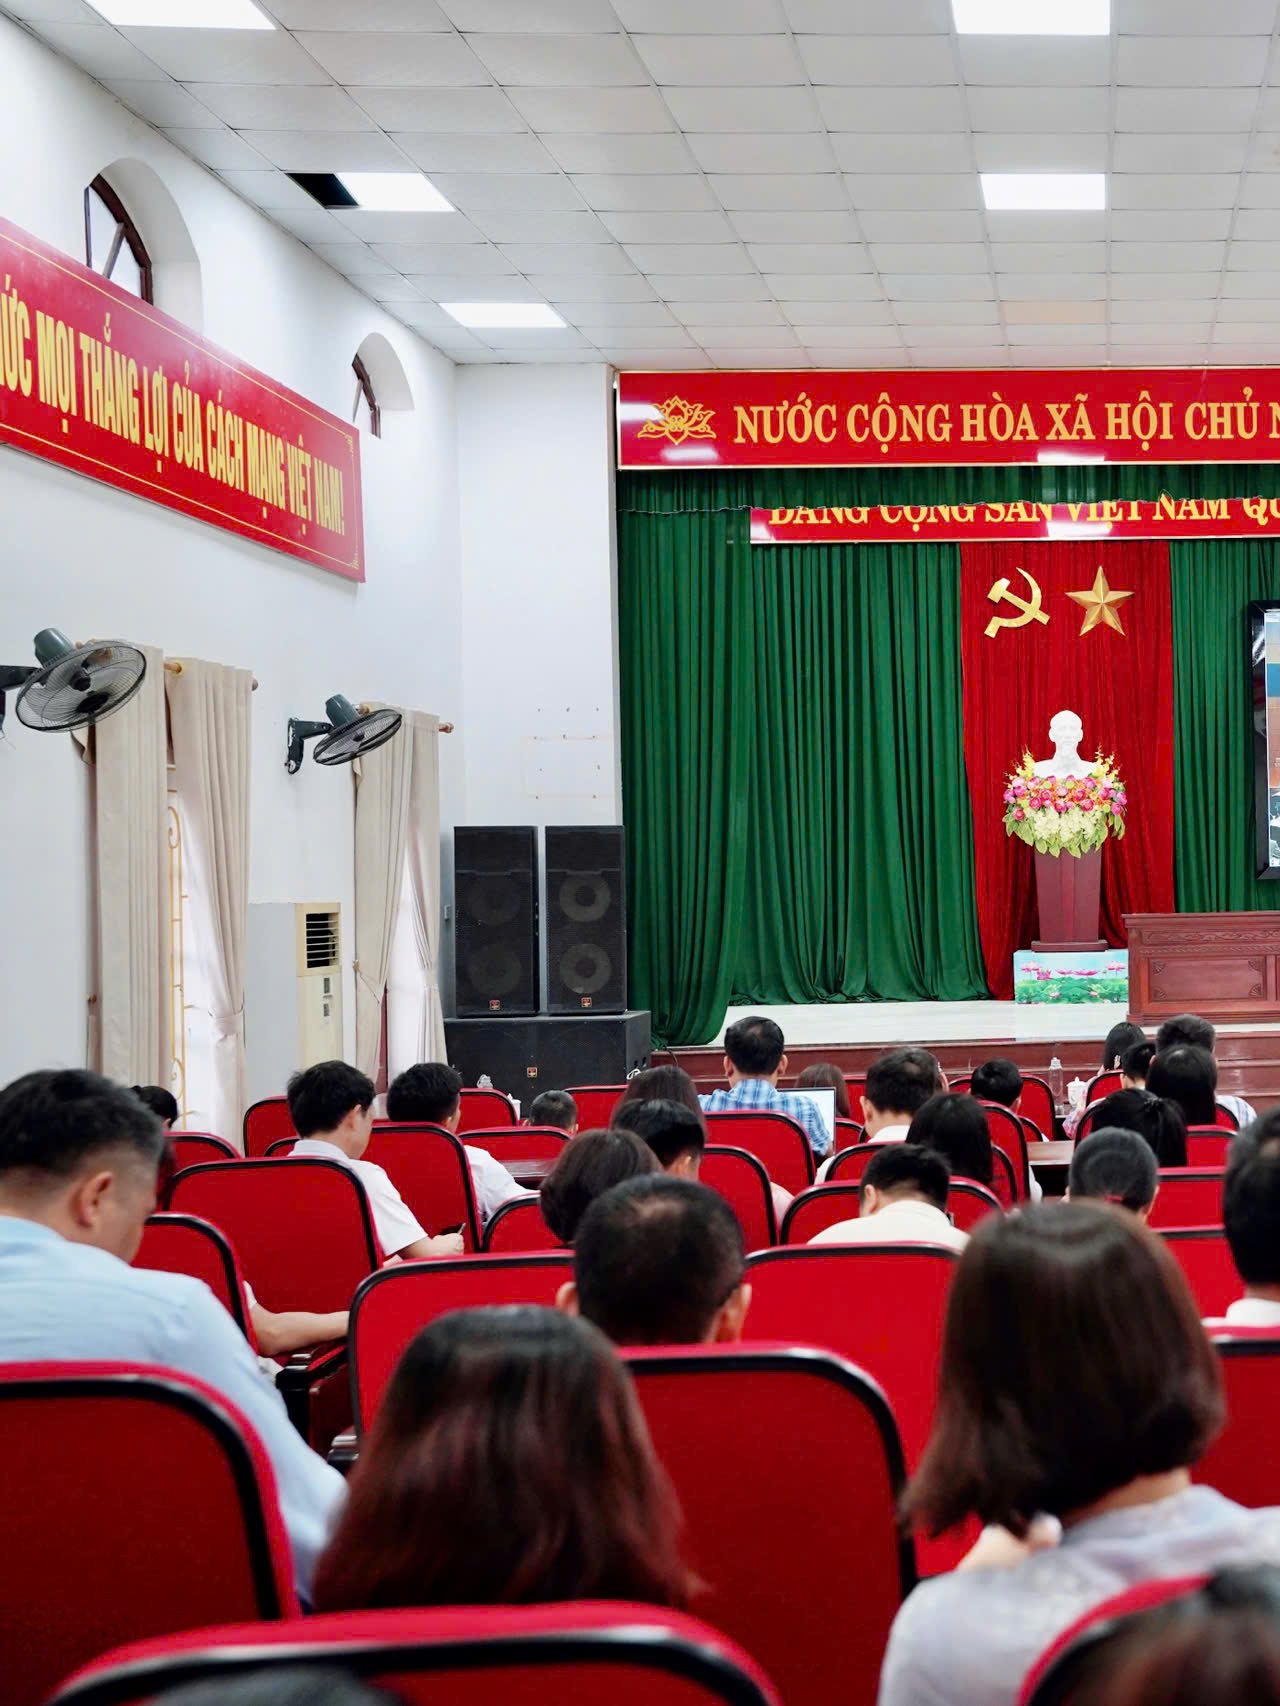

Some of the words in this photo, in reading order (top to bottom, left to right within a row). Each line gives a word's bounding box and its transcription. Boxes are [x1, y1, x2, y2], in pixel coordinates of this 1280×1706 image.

[0, 274, 32, 397] ỨC
[36, 310, 77, 433] MỌI
[80, 312, 140, 445] THẮNG
[143, 365, 169, 473] LỢI
[172, 360, 204, 473] CỦA
[206, 389, 245, 493] CÁCH
[246, 421, 286, 519] MẠNG
[286, 434, 312, 534] VIỆT
[313, 459, 345, 536] NAM!
[734, 392, 837, 444] NƯỚC
[846, 392, 953, 454] CỘNG
[960, 392, 1039, 442] HÒA
[1045, 393, 1096, 441] XÃ
[1105, 390, 1174, 451] HỘI
[1185, 387, 1260, 440] CHỦ
